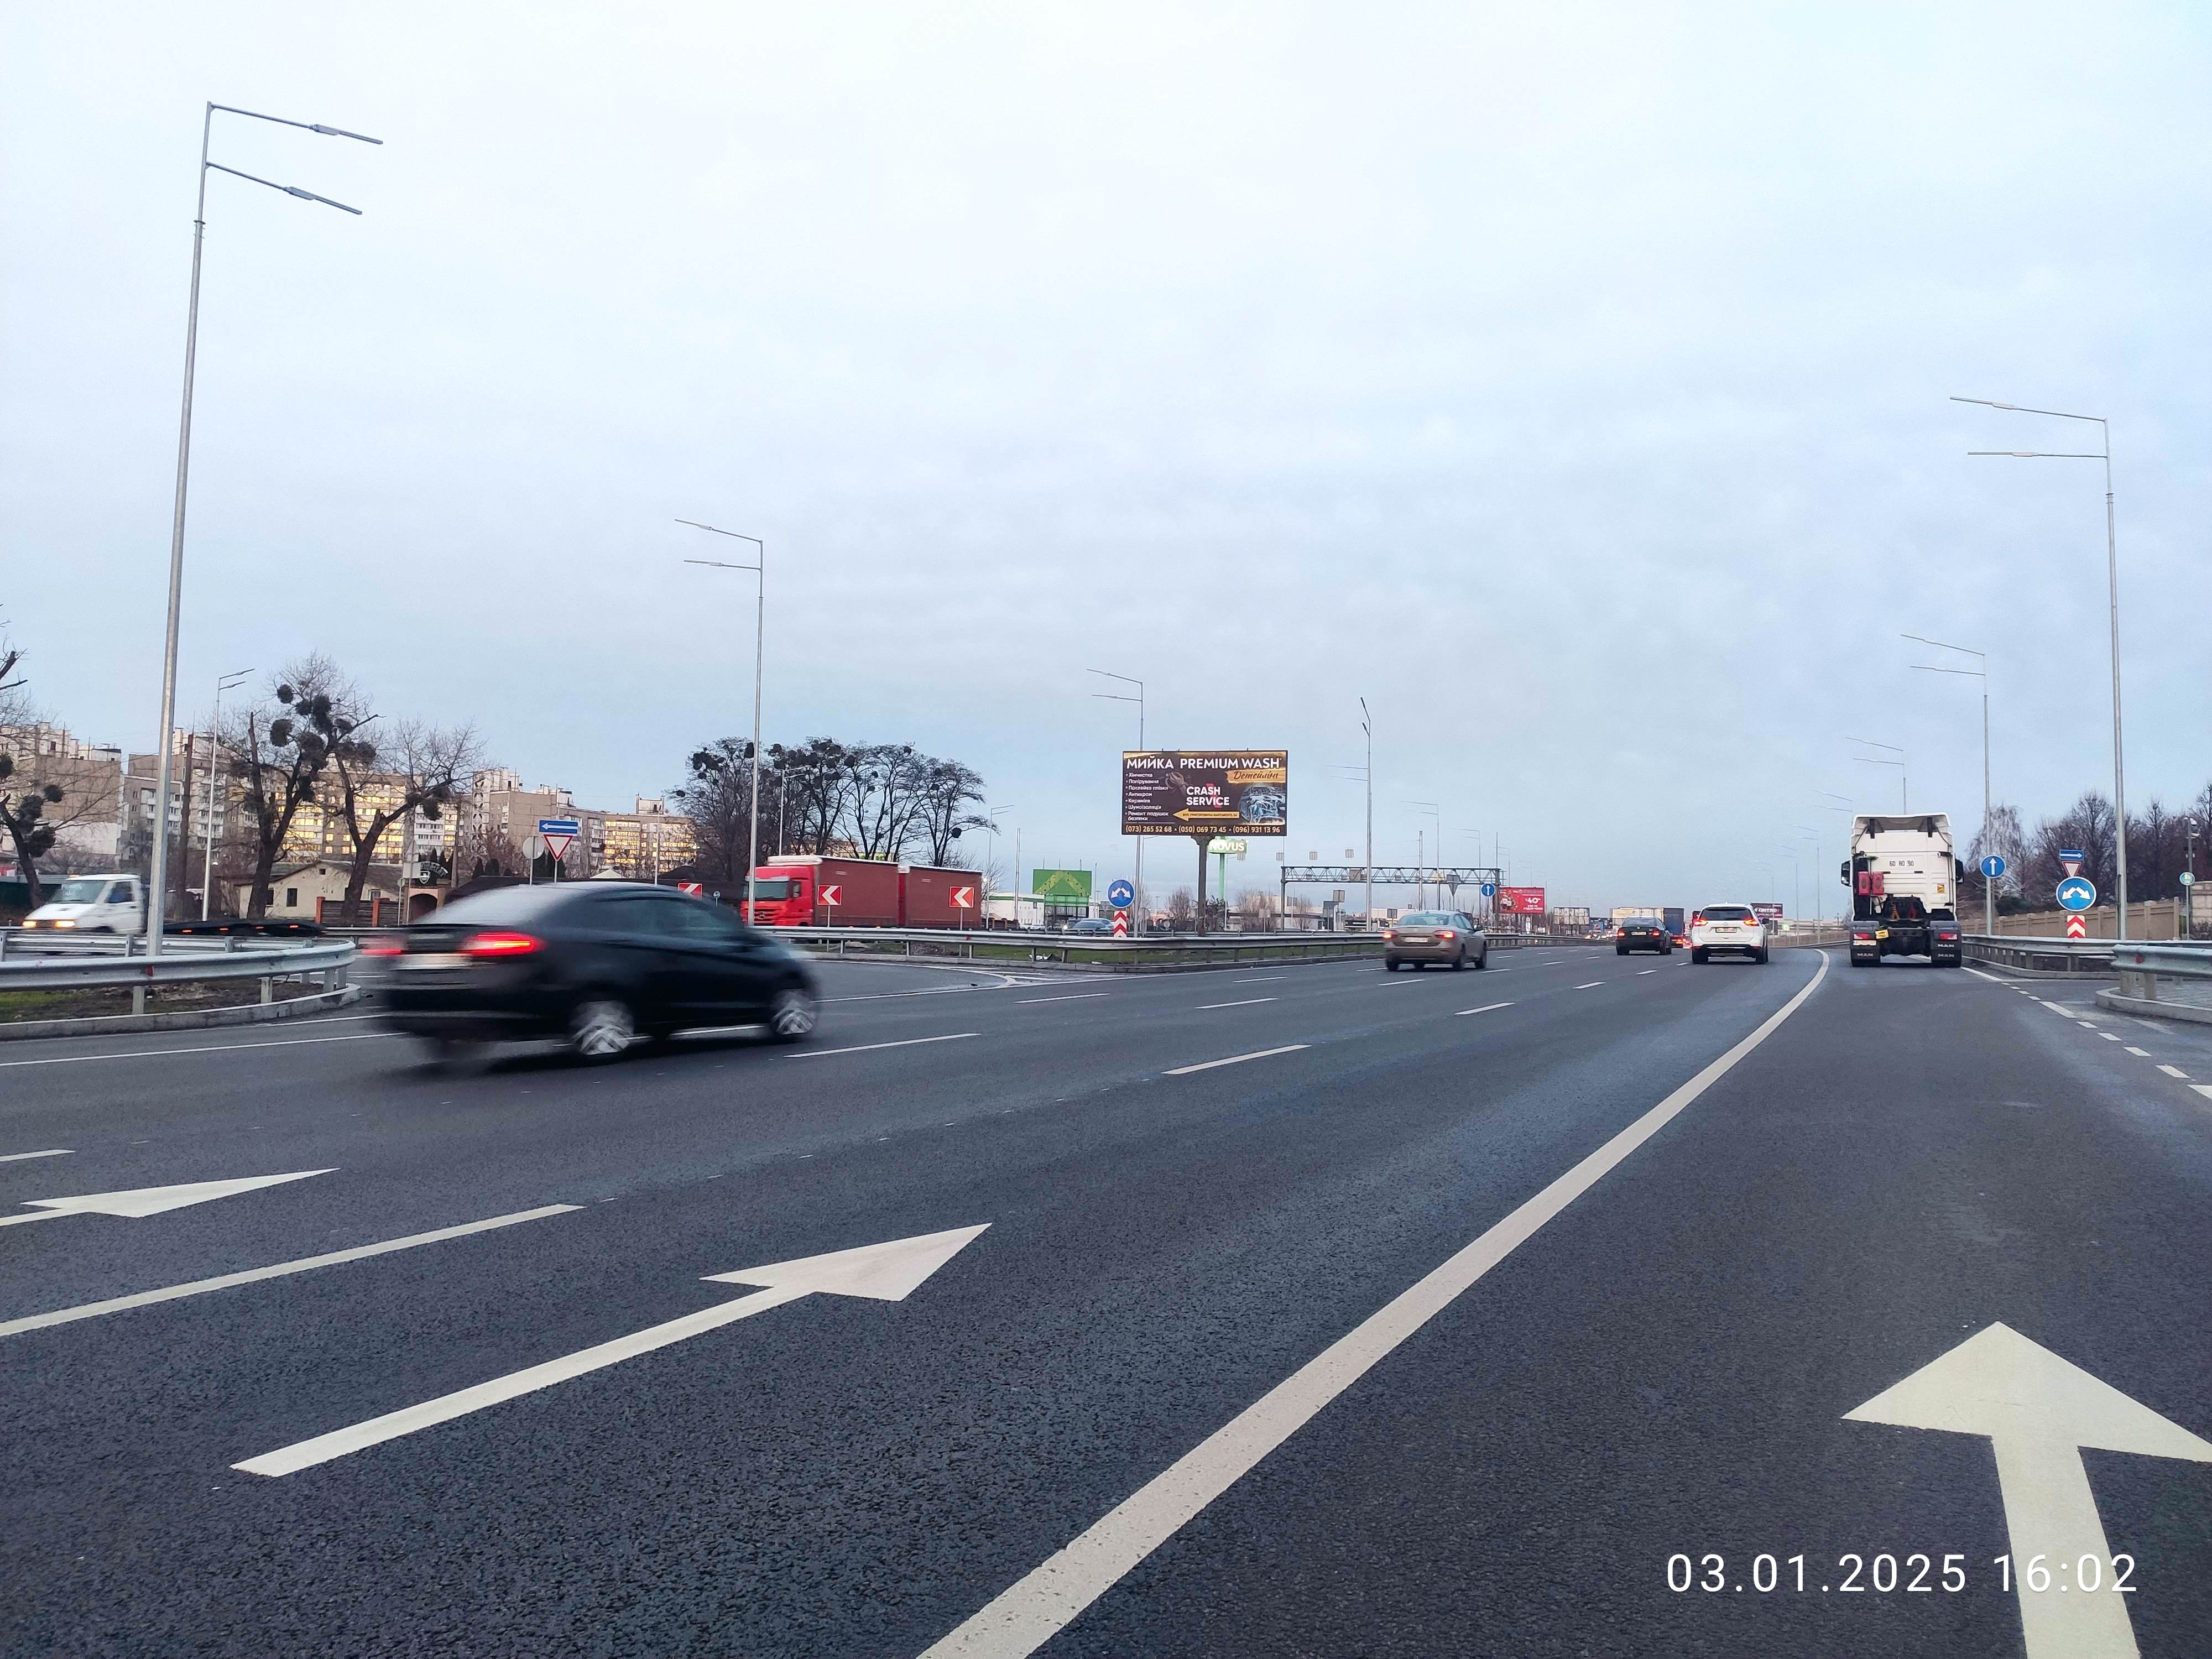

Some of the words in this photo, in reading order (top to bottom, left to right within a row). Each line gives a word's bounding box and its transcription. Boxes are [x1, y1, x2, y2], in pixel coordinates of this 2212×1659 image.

[1126, 755, 1174, 769] МИЙКА
[1180, 758, 1239, 769] PREMIUM
[1241, 758, 1279, 769] WASH
[1186, 786, 1220, 795] CRASH
[1186, 796, 1230, 806] SERVICE
[1126, 824, 1141, 833] (073)
[1178, 825, 1194, 833] (050)
[1233, 825, 1250, 833] (096)
